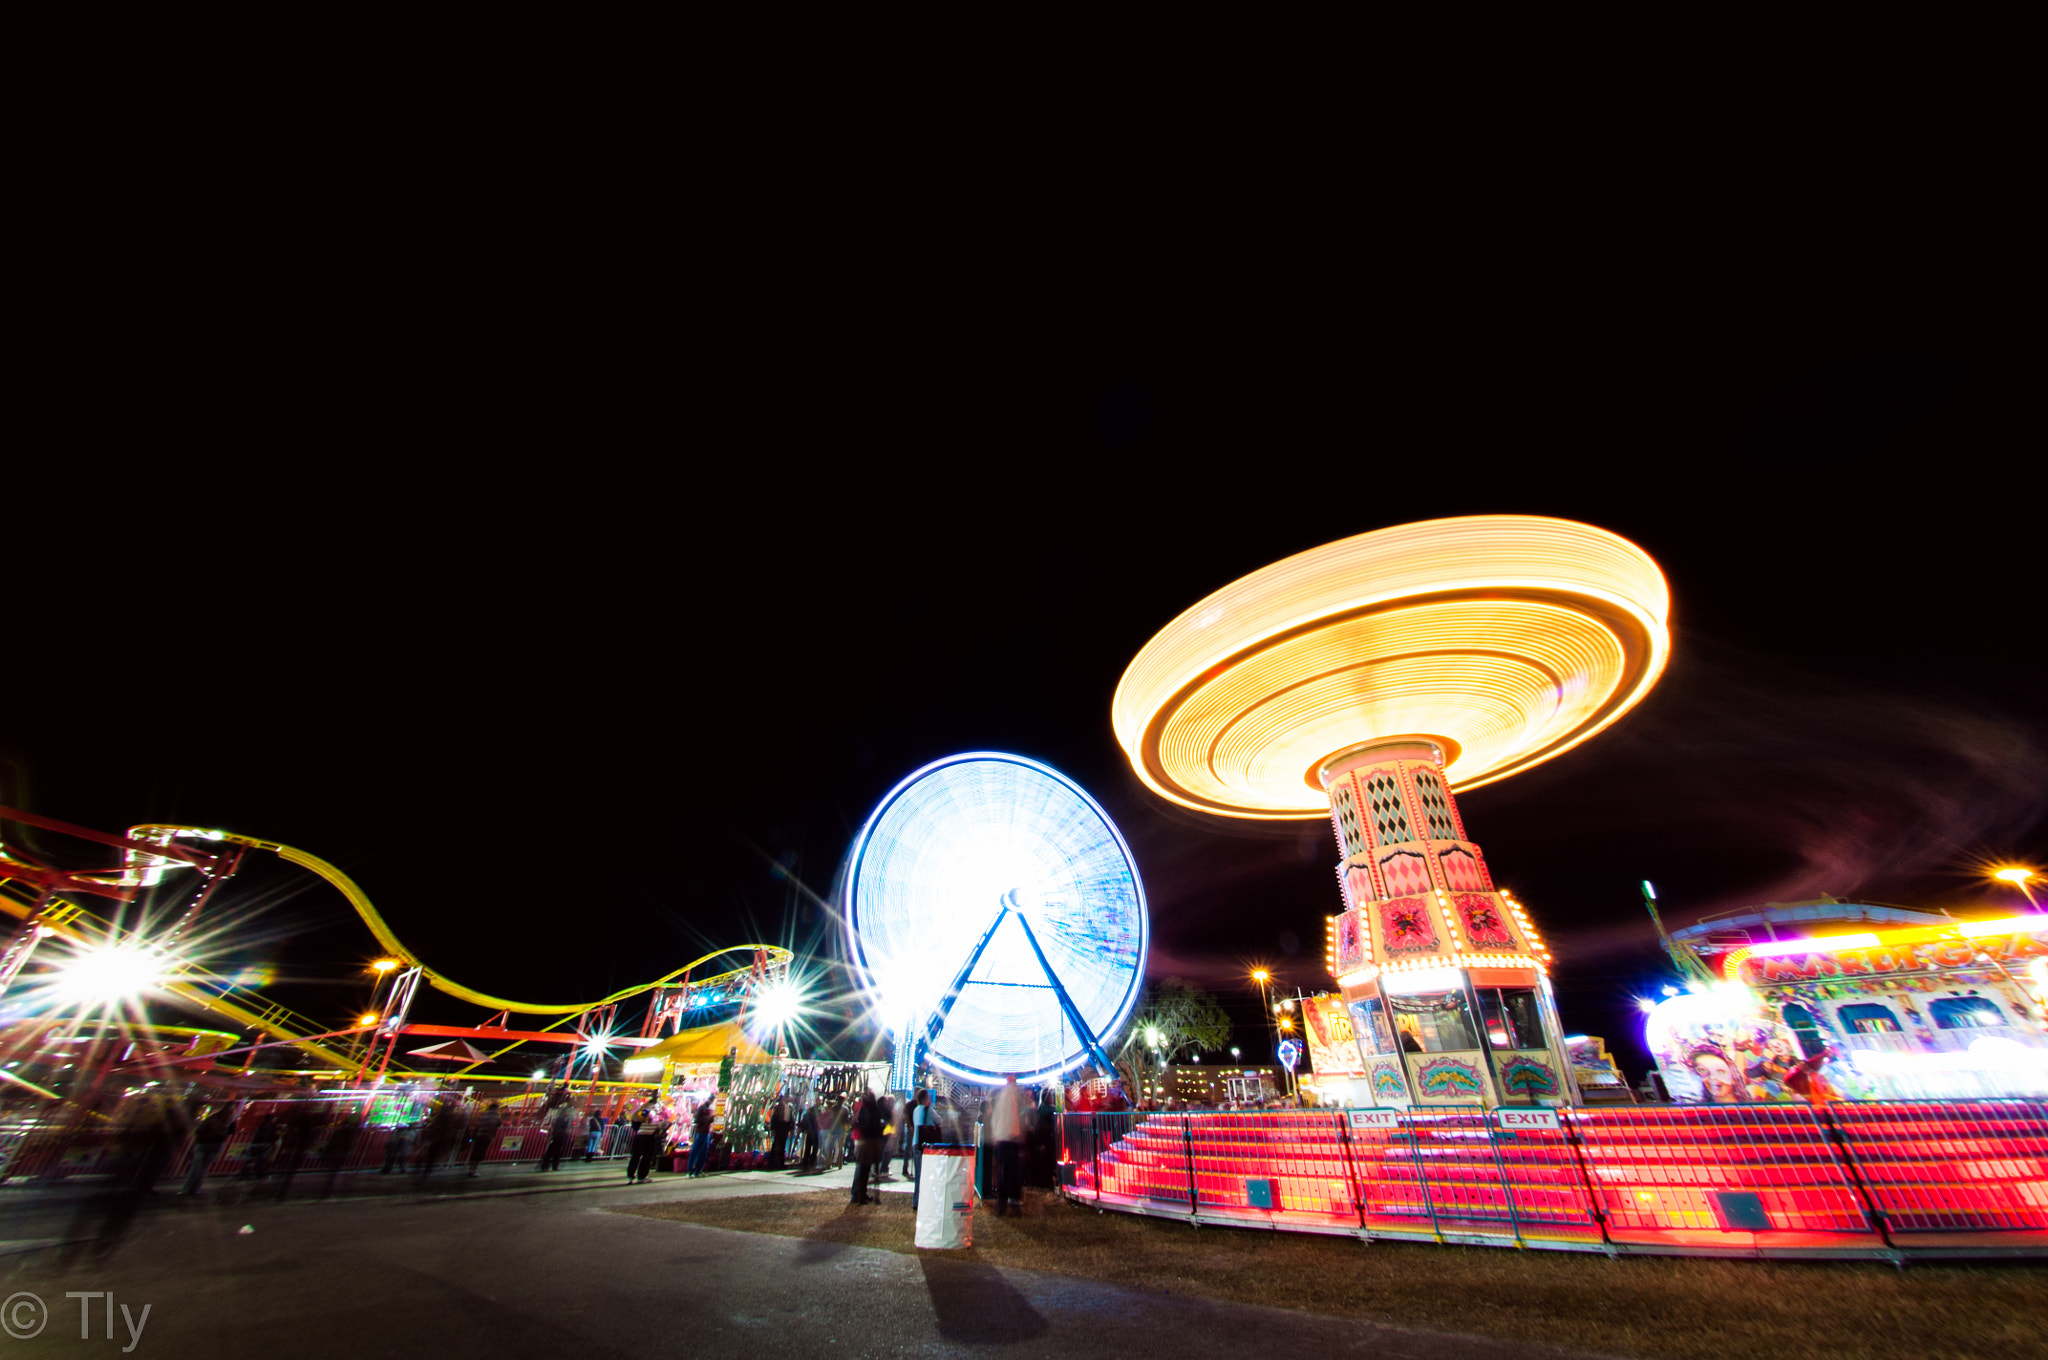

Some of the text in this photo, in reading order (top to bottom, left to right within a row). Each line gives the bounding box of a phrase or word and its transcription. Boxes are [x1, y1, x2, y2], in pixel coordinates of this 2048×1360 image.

[1762, 944, 1921, 981] MARDI
[1353, 1113, 1392, 1125] EXIT
[1504, 1113, 1551, 1125] EXIT
